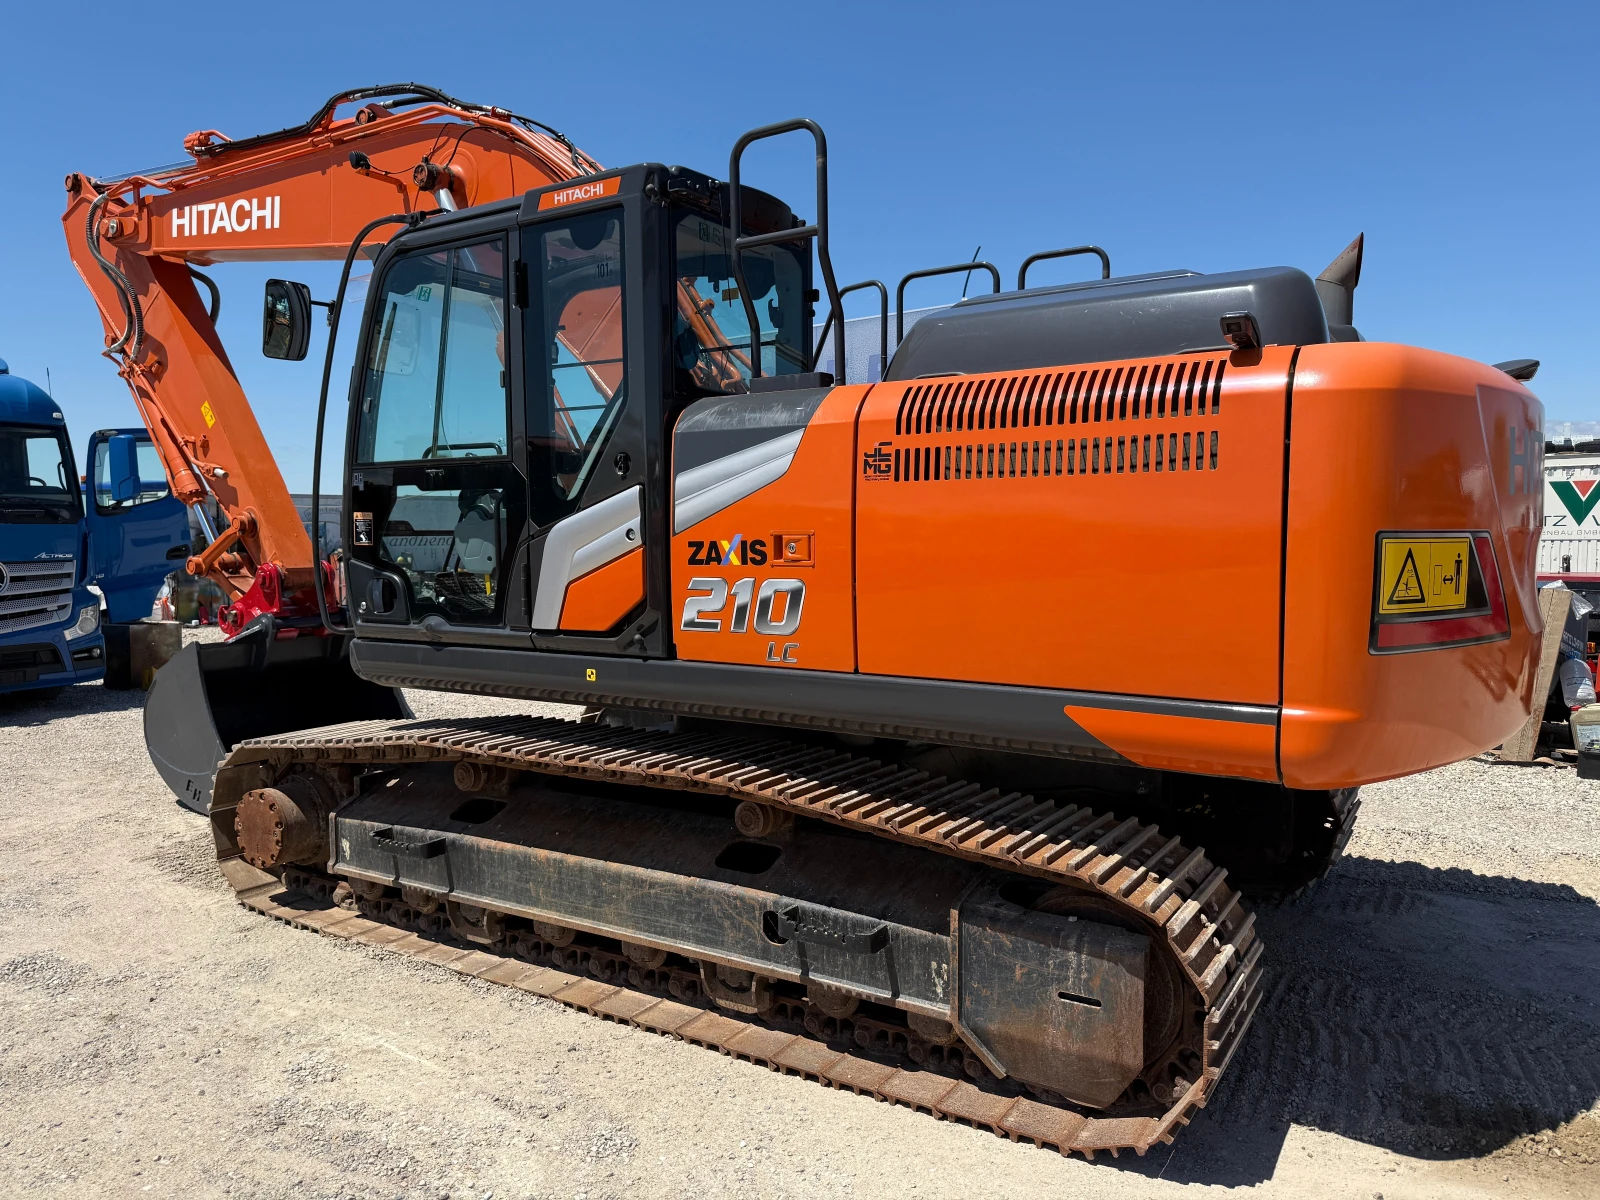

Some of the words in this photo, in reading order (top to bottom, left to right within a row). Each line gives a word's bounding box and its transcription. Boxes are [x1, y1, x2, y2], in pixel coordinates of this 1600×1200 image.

[554, 183, 604, 205] HITACHI
[171, 196, 281, 238] HITACHI
[687, 533, 768, 566] ZAXIS
[680, 576, 806, 636] 210
[766, 641, 800, 663] LC
